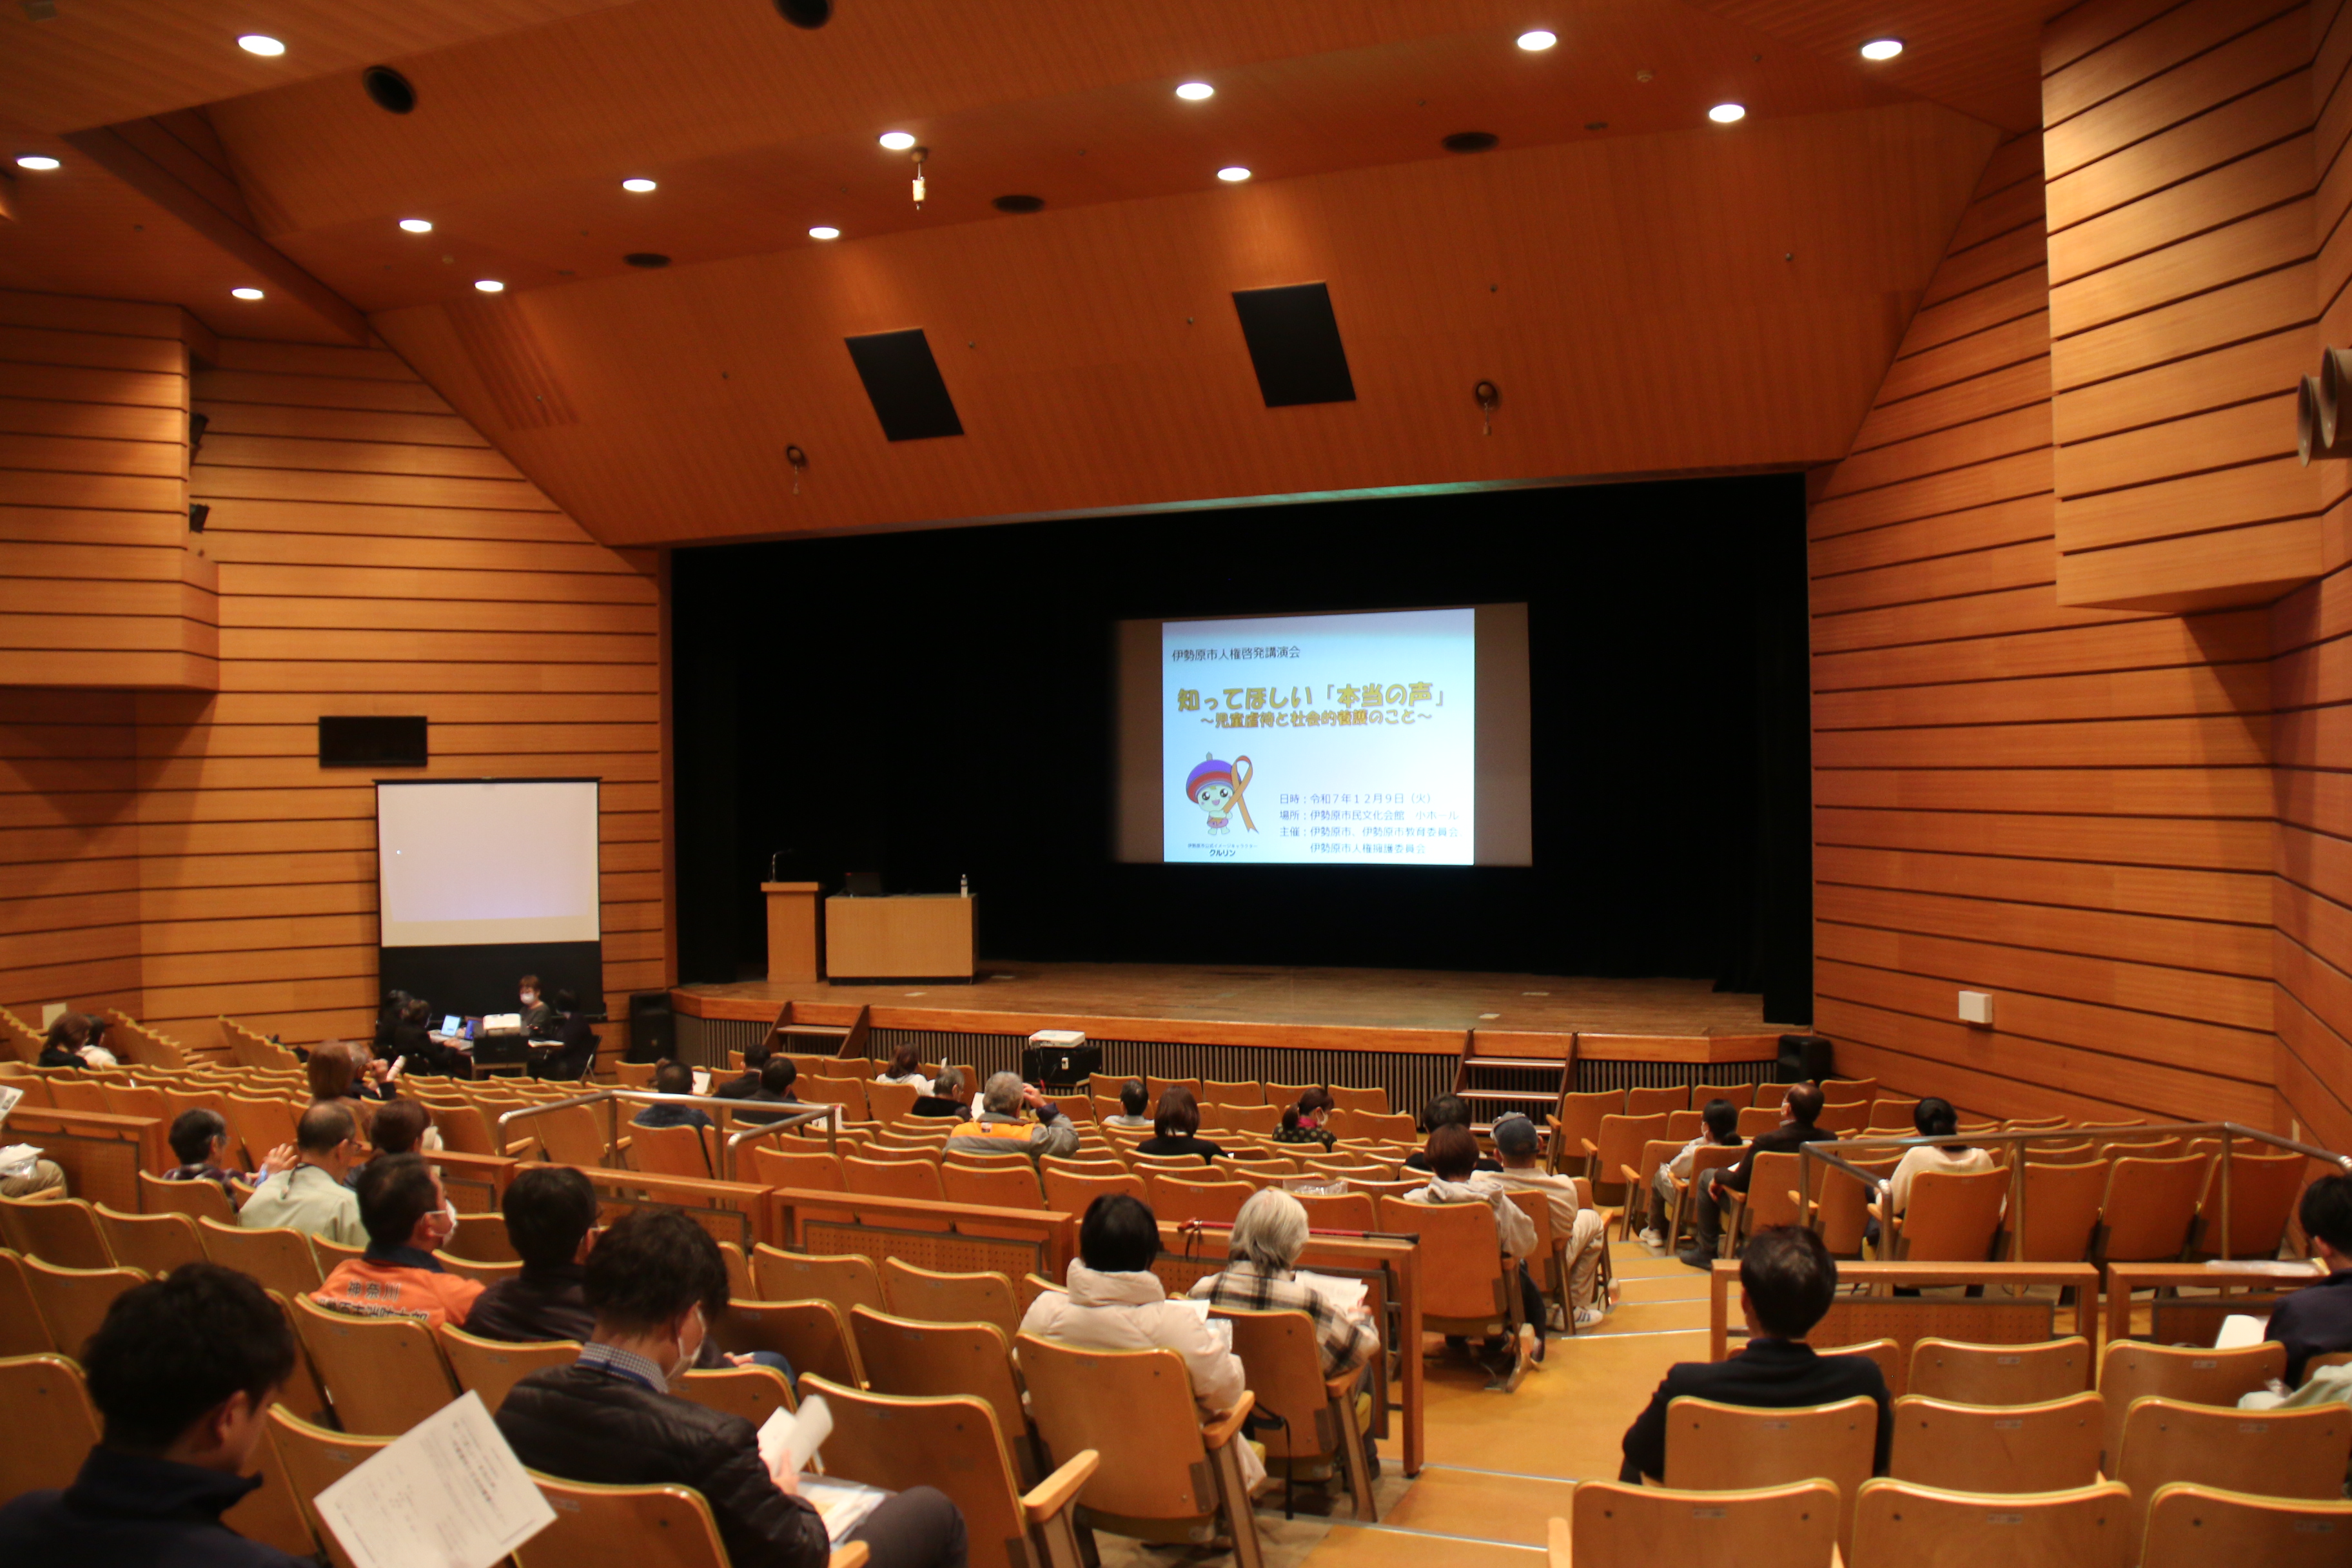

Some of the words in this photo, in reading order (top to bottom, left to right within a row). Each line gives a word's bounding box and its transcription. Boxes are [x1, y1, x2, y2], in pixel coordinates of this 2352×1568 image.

[1171, 646, 1300, 662] 伊勢原市人権啓発講演会
[1177, 681, 1444, 712] 知ってほしい「本当の声」
[1415, 810, 1459, 821] 小ホール
[1309, 843, 1426, 854] 伊勢原市人権擁護委員会
[347, 1280, 401, 1301] 神奈川
